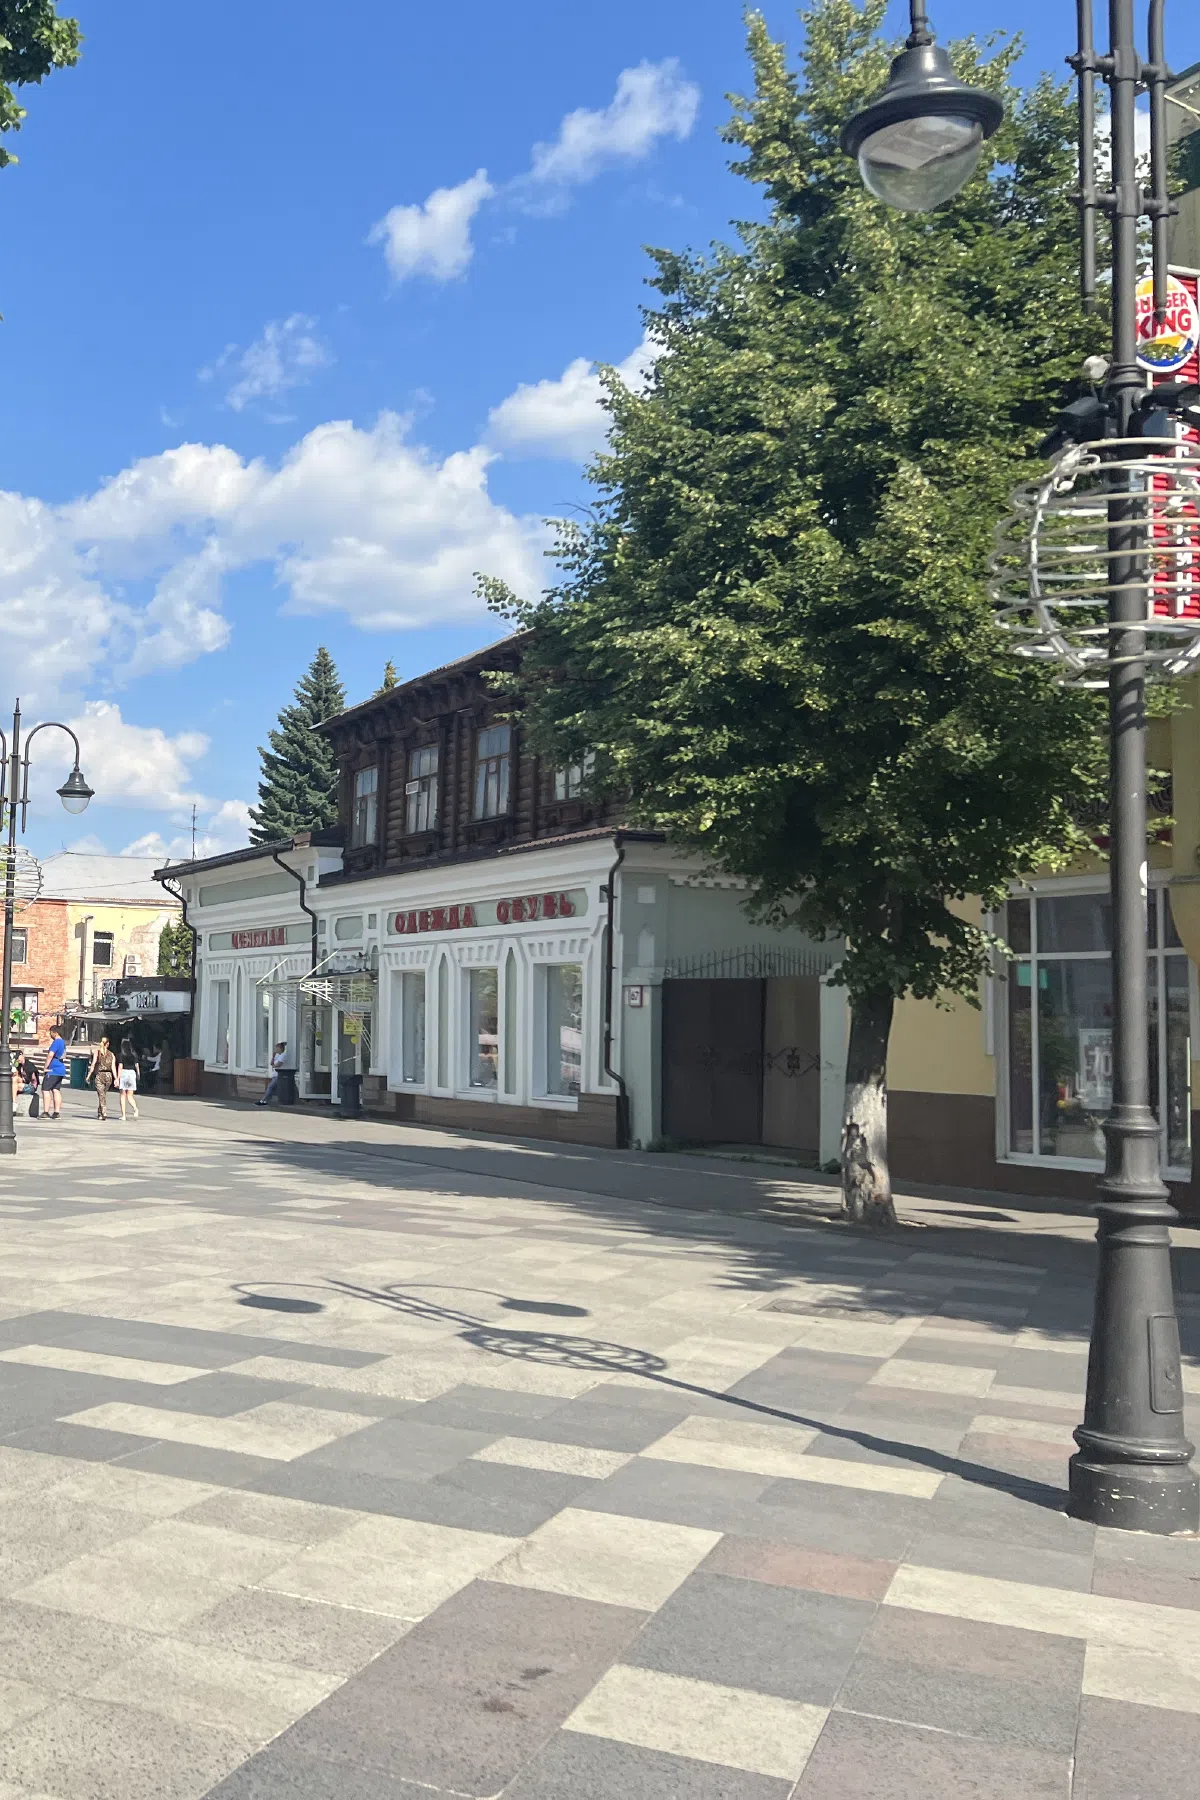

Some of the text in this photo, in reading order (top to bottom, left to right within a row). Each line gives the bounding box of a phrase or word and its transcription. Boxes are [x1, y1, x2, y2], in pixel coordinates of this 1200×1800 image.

[1136, 308, 1191, 340] KING
[394, 893, 576, 934] ОДЕЖДА ОБУВЬ
